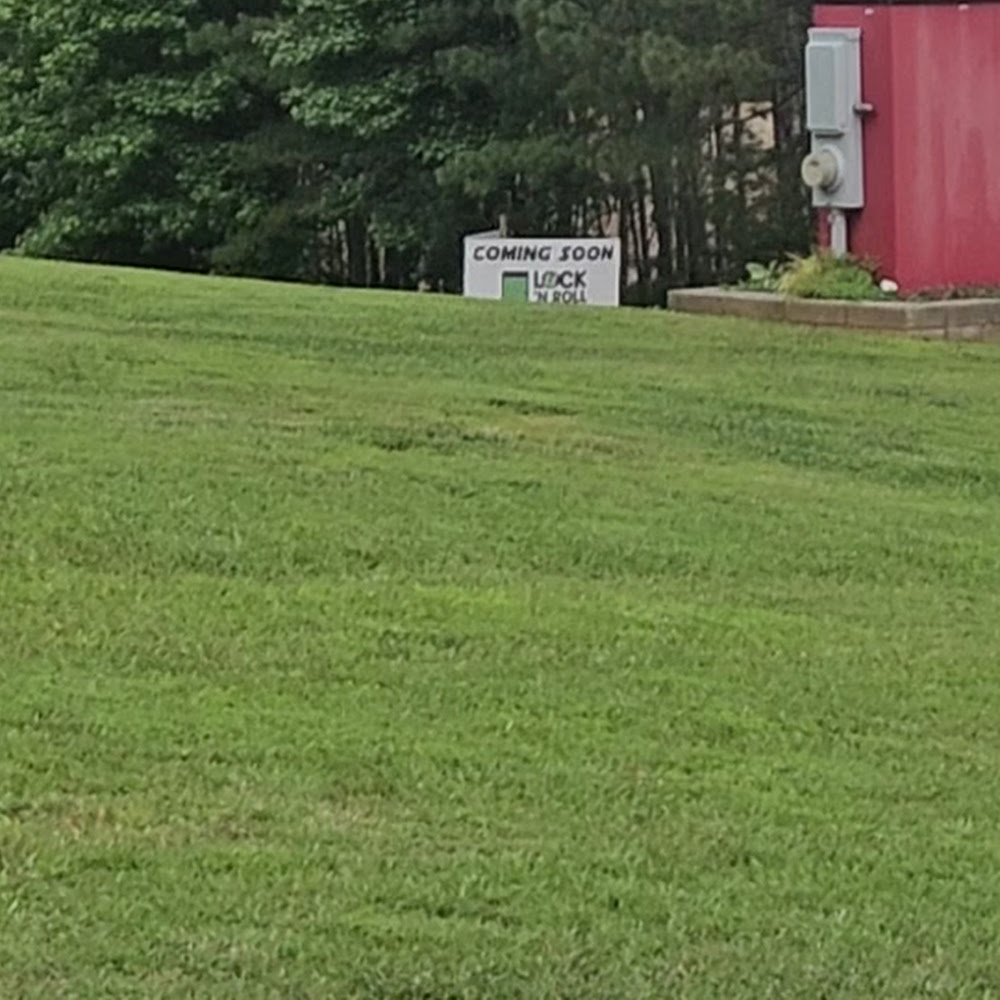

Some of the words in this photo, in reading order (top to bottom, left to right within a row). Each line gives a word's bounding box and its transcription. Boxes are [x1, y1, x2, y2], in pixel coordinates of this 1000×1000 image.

[473, 245, 552, 262] COMING
[558, 245, 614, 261] SOON
[533, 270, 587, 289] LOCK
